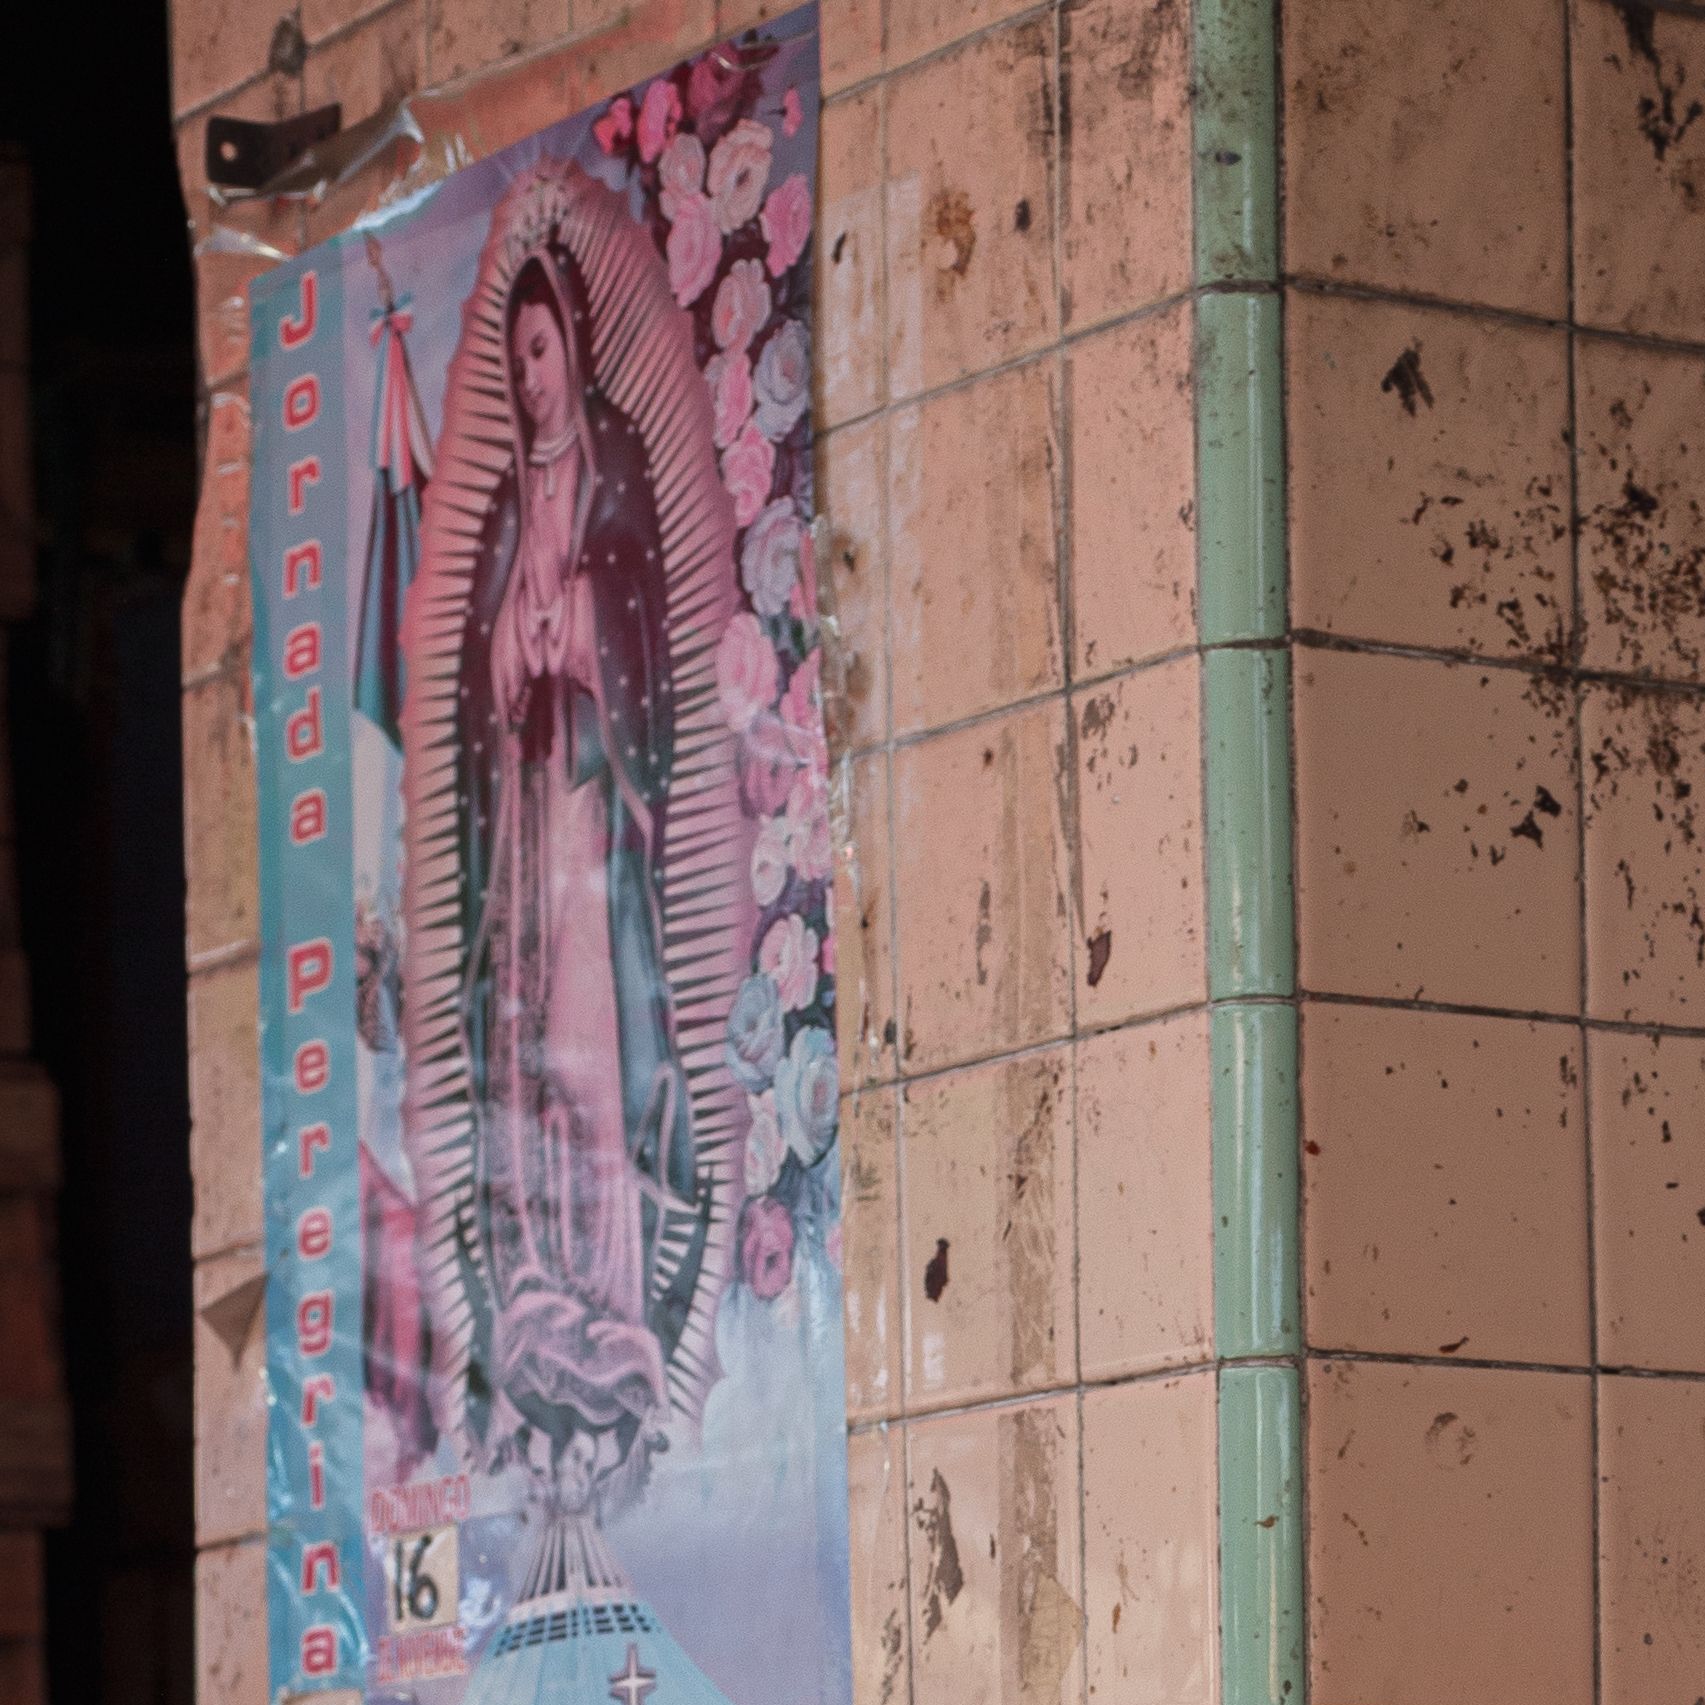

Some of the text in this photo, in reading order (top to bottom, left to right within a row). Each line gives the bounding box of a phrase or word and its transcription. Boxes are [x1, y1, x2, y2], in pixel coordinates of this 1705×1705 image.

[278, 269, 342, 1678] Jornada Peregrina
[393, 1534, 439, 1622] 16
